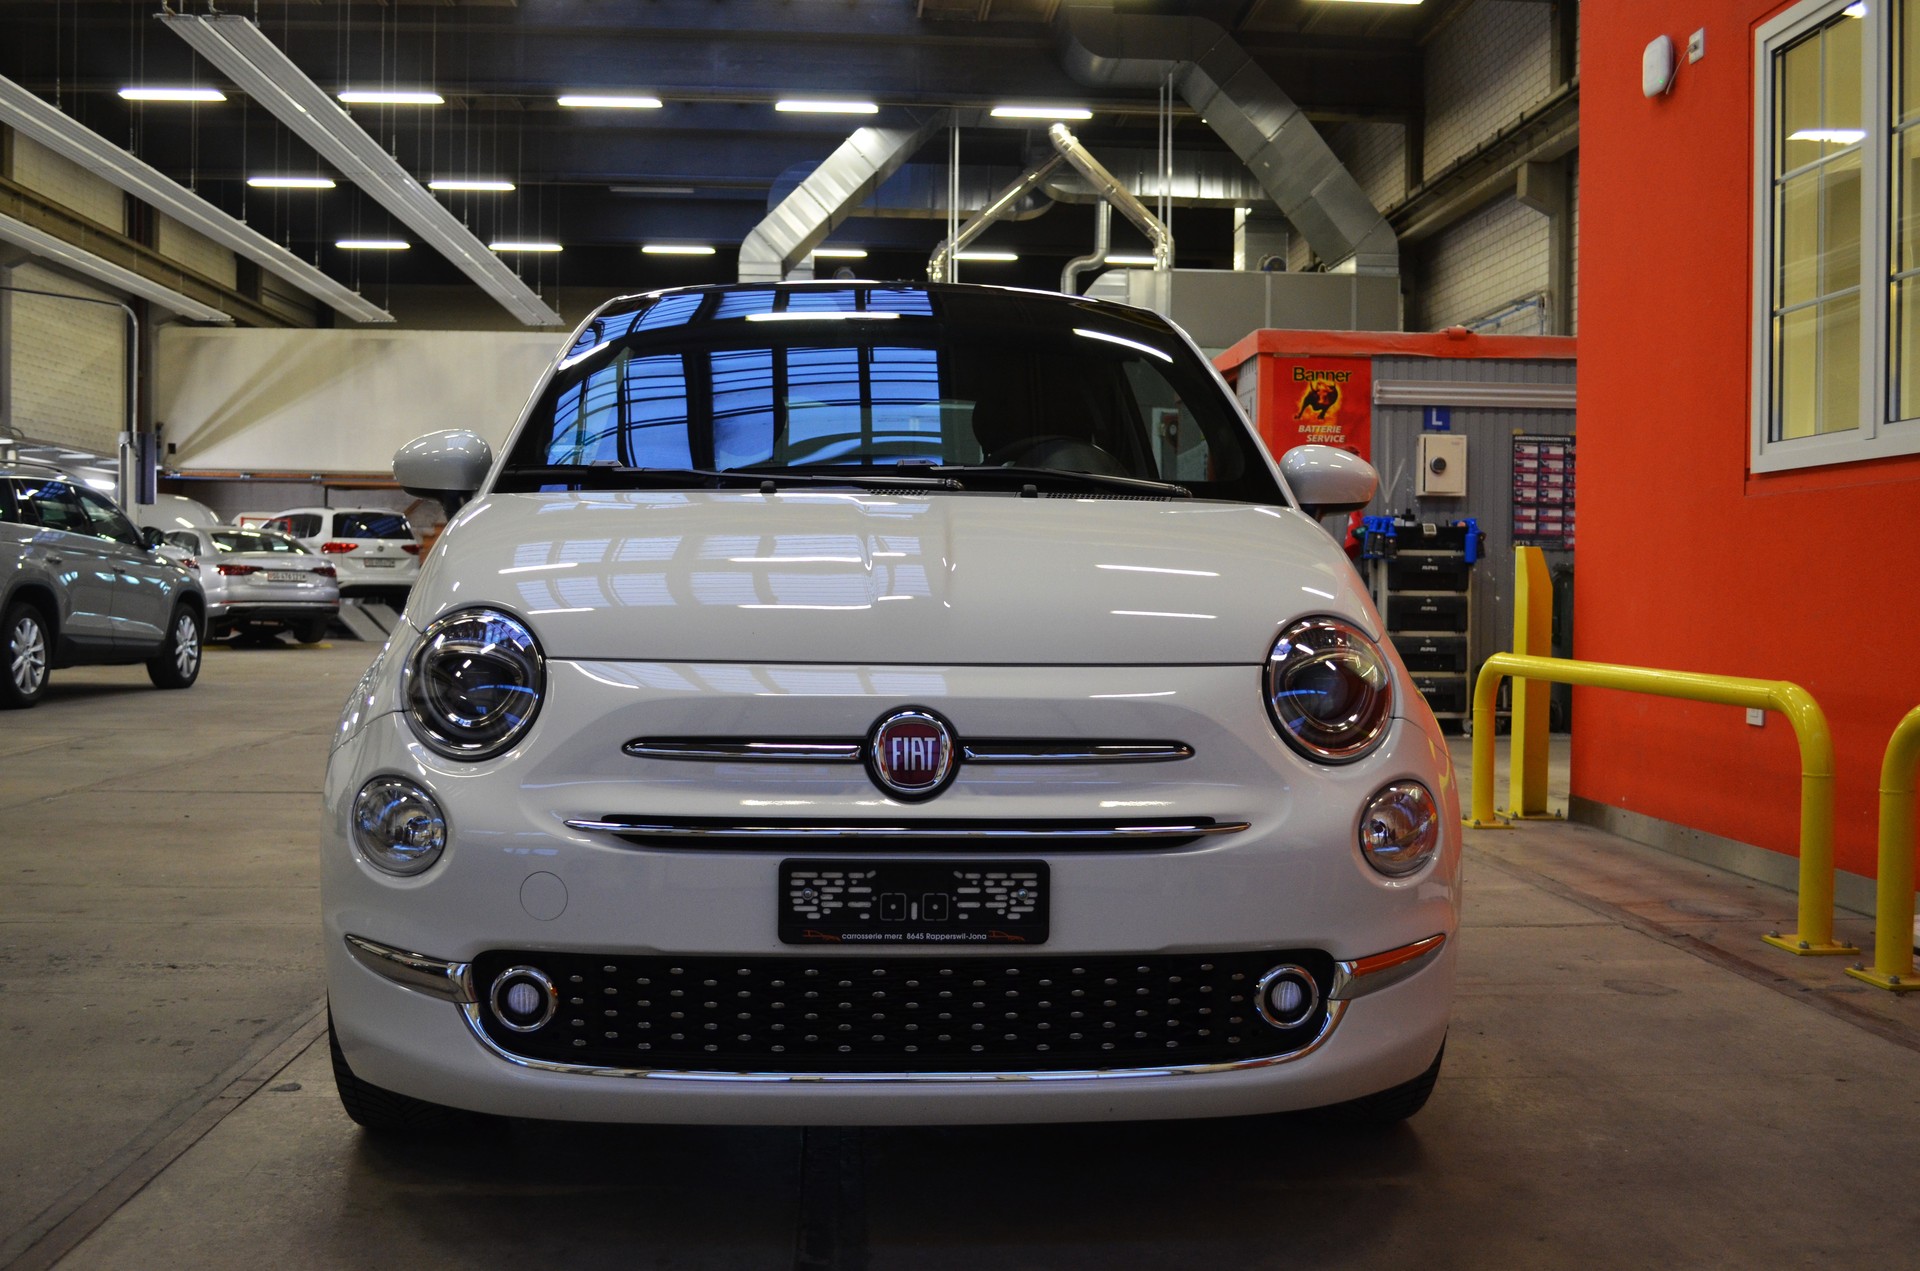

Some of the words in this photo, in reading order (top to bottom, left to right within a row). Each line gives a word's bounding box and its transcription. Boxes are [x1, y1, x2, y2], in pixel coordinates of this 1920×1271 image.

[1293, 366, 1352, 382] Banner
[1431, 408, 1442, 426] L
[1298, 425, 1342, 434] BATTERIE
[1306, 434, 1345, 443] SERVICE
[892, 737, 936, 771] FIAT
[841, 932, 883, 940] carrosserie
[906, 932, 925, 940] 8645
[926, 932, 988, 942] Rapperswil-Jona
